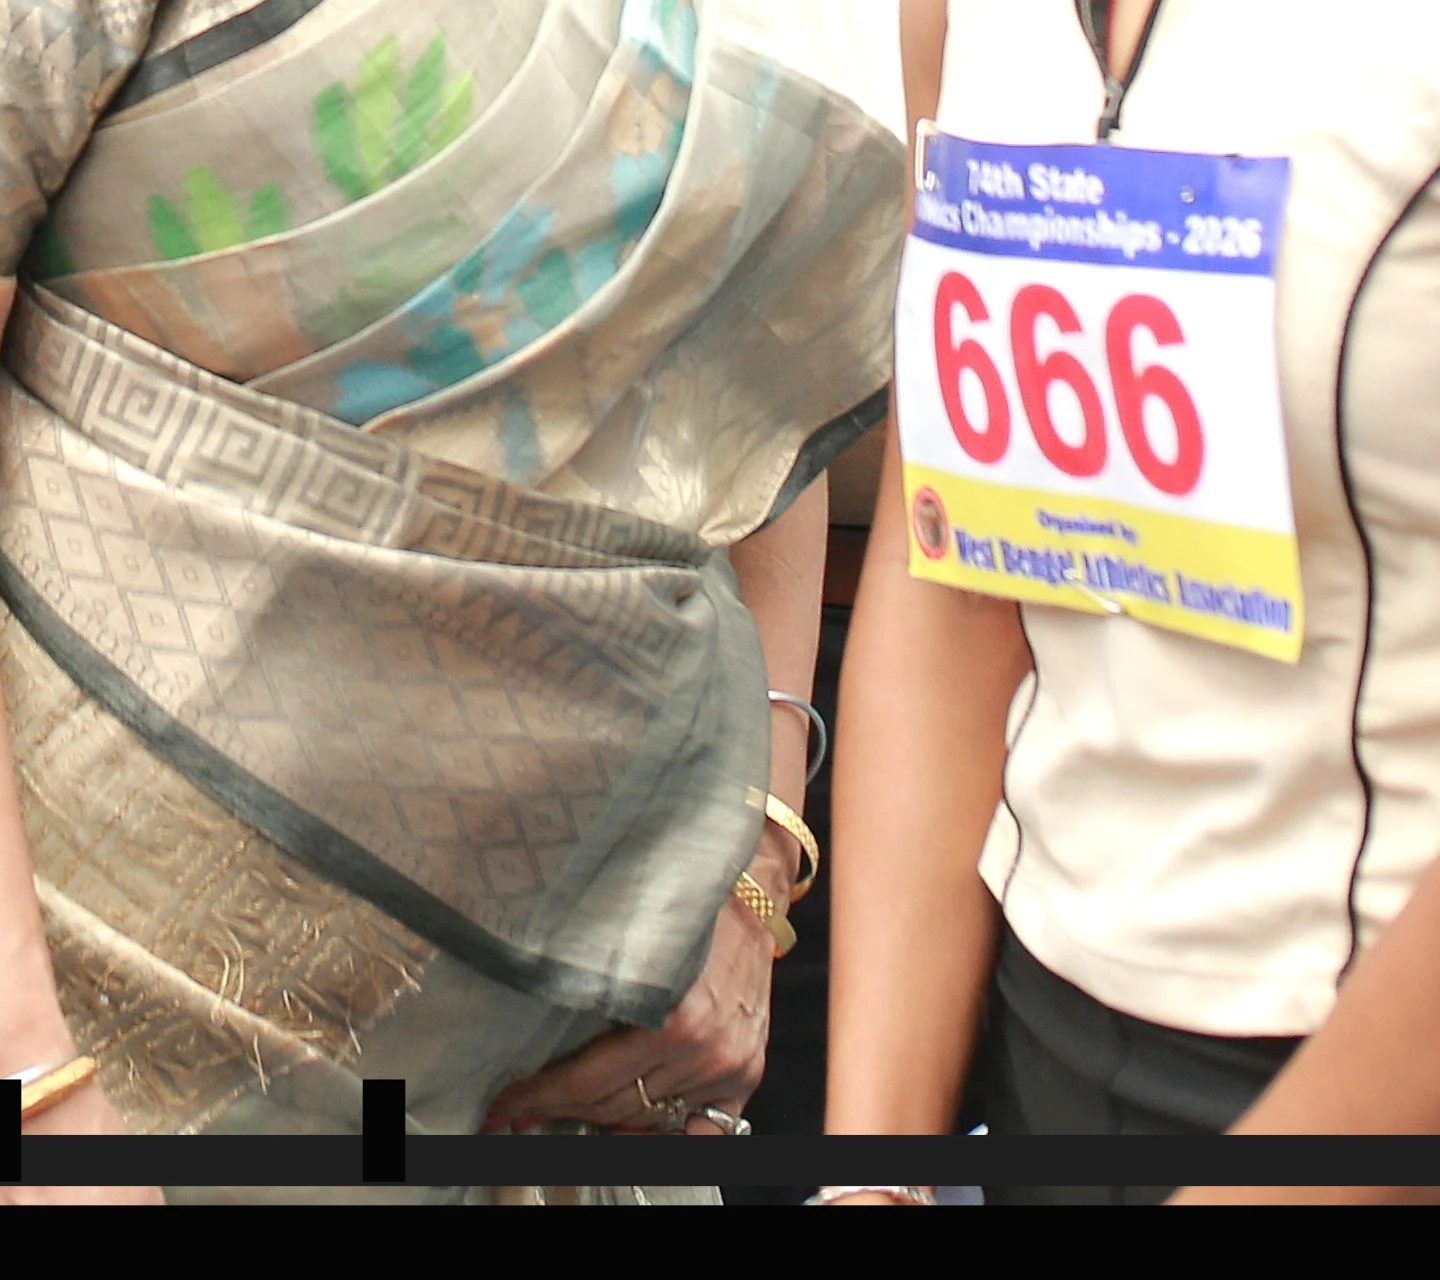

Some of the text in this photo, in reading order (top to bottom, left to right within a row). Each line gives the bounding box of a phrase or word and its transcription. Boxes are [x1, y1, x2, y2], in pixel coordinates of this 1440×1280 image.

[1027, 160, 1106, 206] State
[961, 198, 1165, 261] Championships
[934, 269, 1206, 498] 666
[954, 528, 996, 572] West
